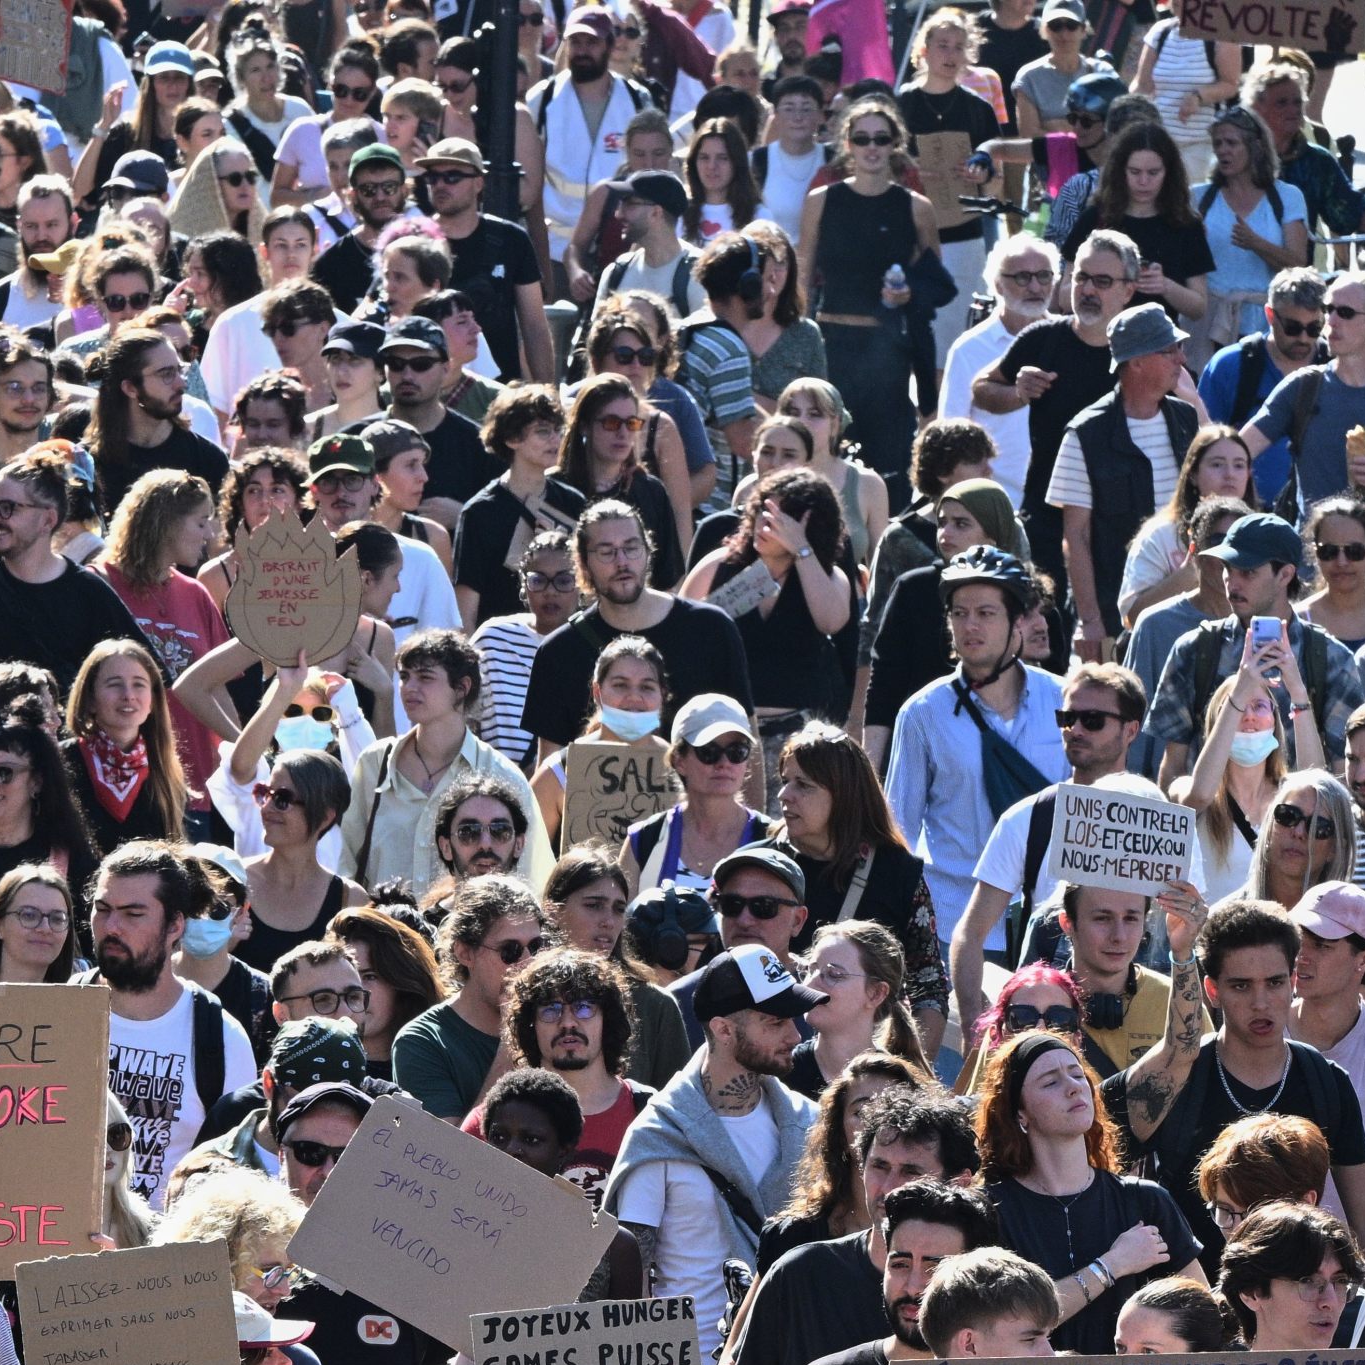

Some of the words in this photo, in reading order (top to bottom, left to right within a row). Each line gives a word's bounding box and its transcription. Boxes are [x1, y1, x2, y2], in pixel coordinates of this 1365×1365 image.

[262, 561, 321, 574] PORTRAIT
[273, 574, 312, 586] D'UNE
[257, 588, 320, 601] JEUNESSE
[278, 602, 298, 614] EN
[266, 616, 306, 627] FEU
[372, 1127, 394, 1149] EL
[403, 1142, 462, 1181] PUEBLO
[474, 1179, 528, 1218] UNIDO
[372, 1216, 451, 1275] VENCIDO
[184, 1270, 218, 1286] NOUS
[40, 1319, 114, 1337] EXPRIMER
[120, 1311, 155, 1328] SANS
[165, 1307, 197, 1321] NOUS
[482, 1310, 591, 1345] JOYEUX
[601, 1297, 695, 1328] HUNGER
